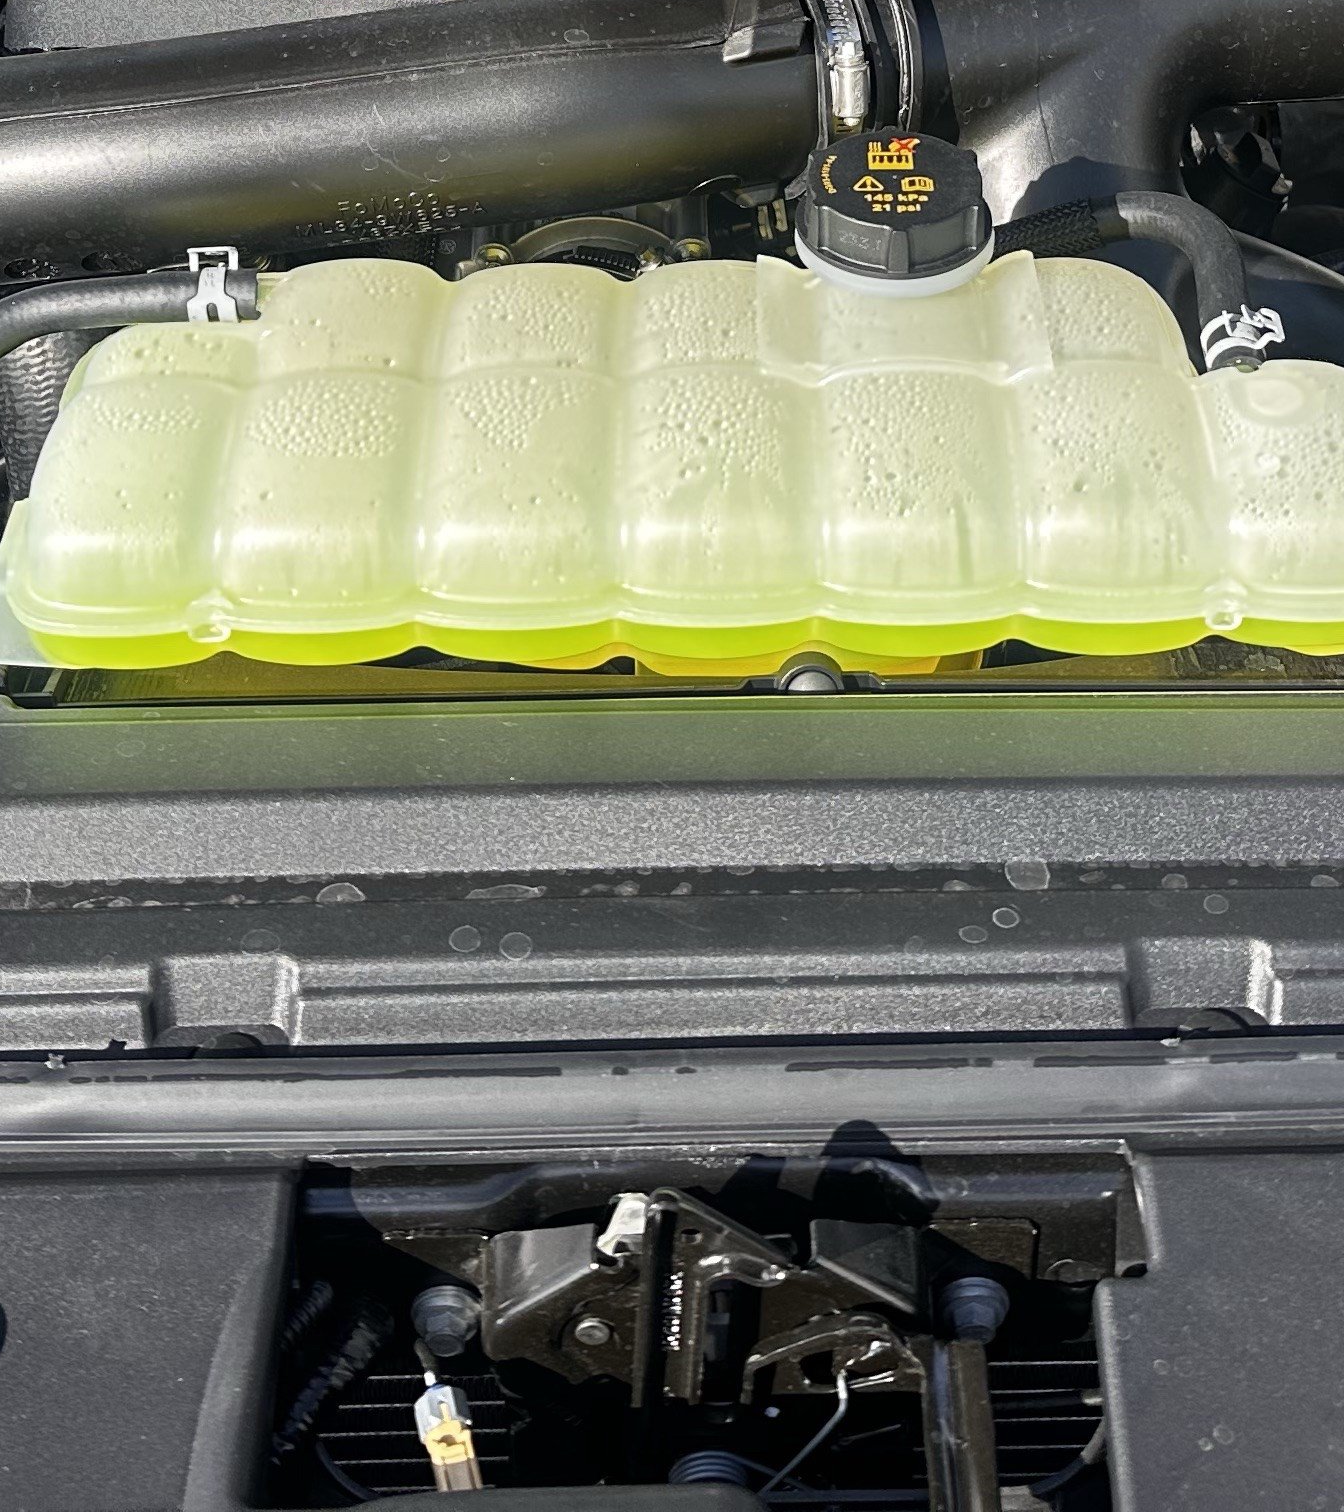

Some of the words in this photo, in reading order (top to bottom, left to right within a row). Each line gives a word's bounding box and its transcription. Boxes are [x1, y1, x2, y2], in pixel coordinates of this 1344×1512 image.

[864, 193, 894, 202] 145
[897, 193, 929, 202] kPa
[337, 191, 439, 220] FoMoCo
[872, 203, 892, 212] 21
[896, 203, 922, 214] psi
